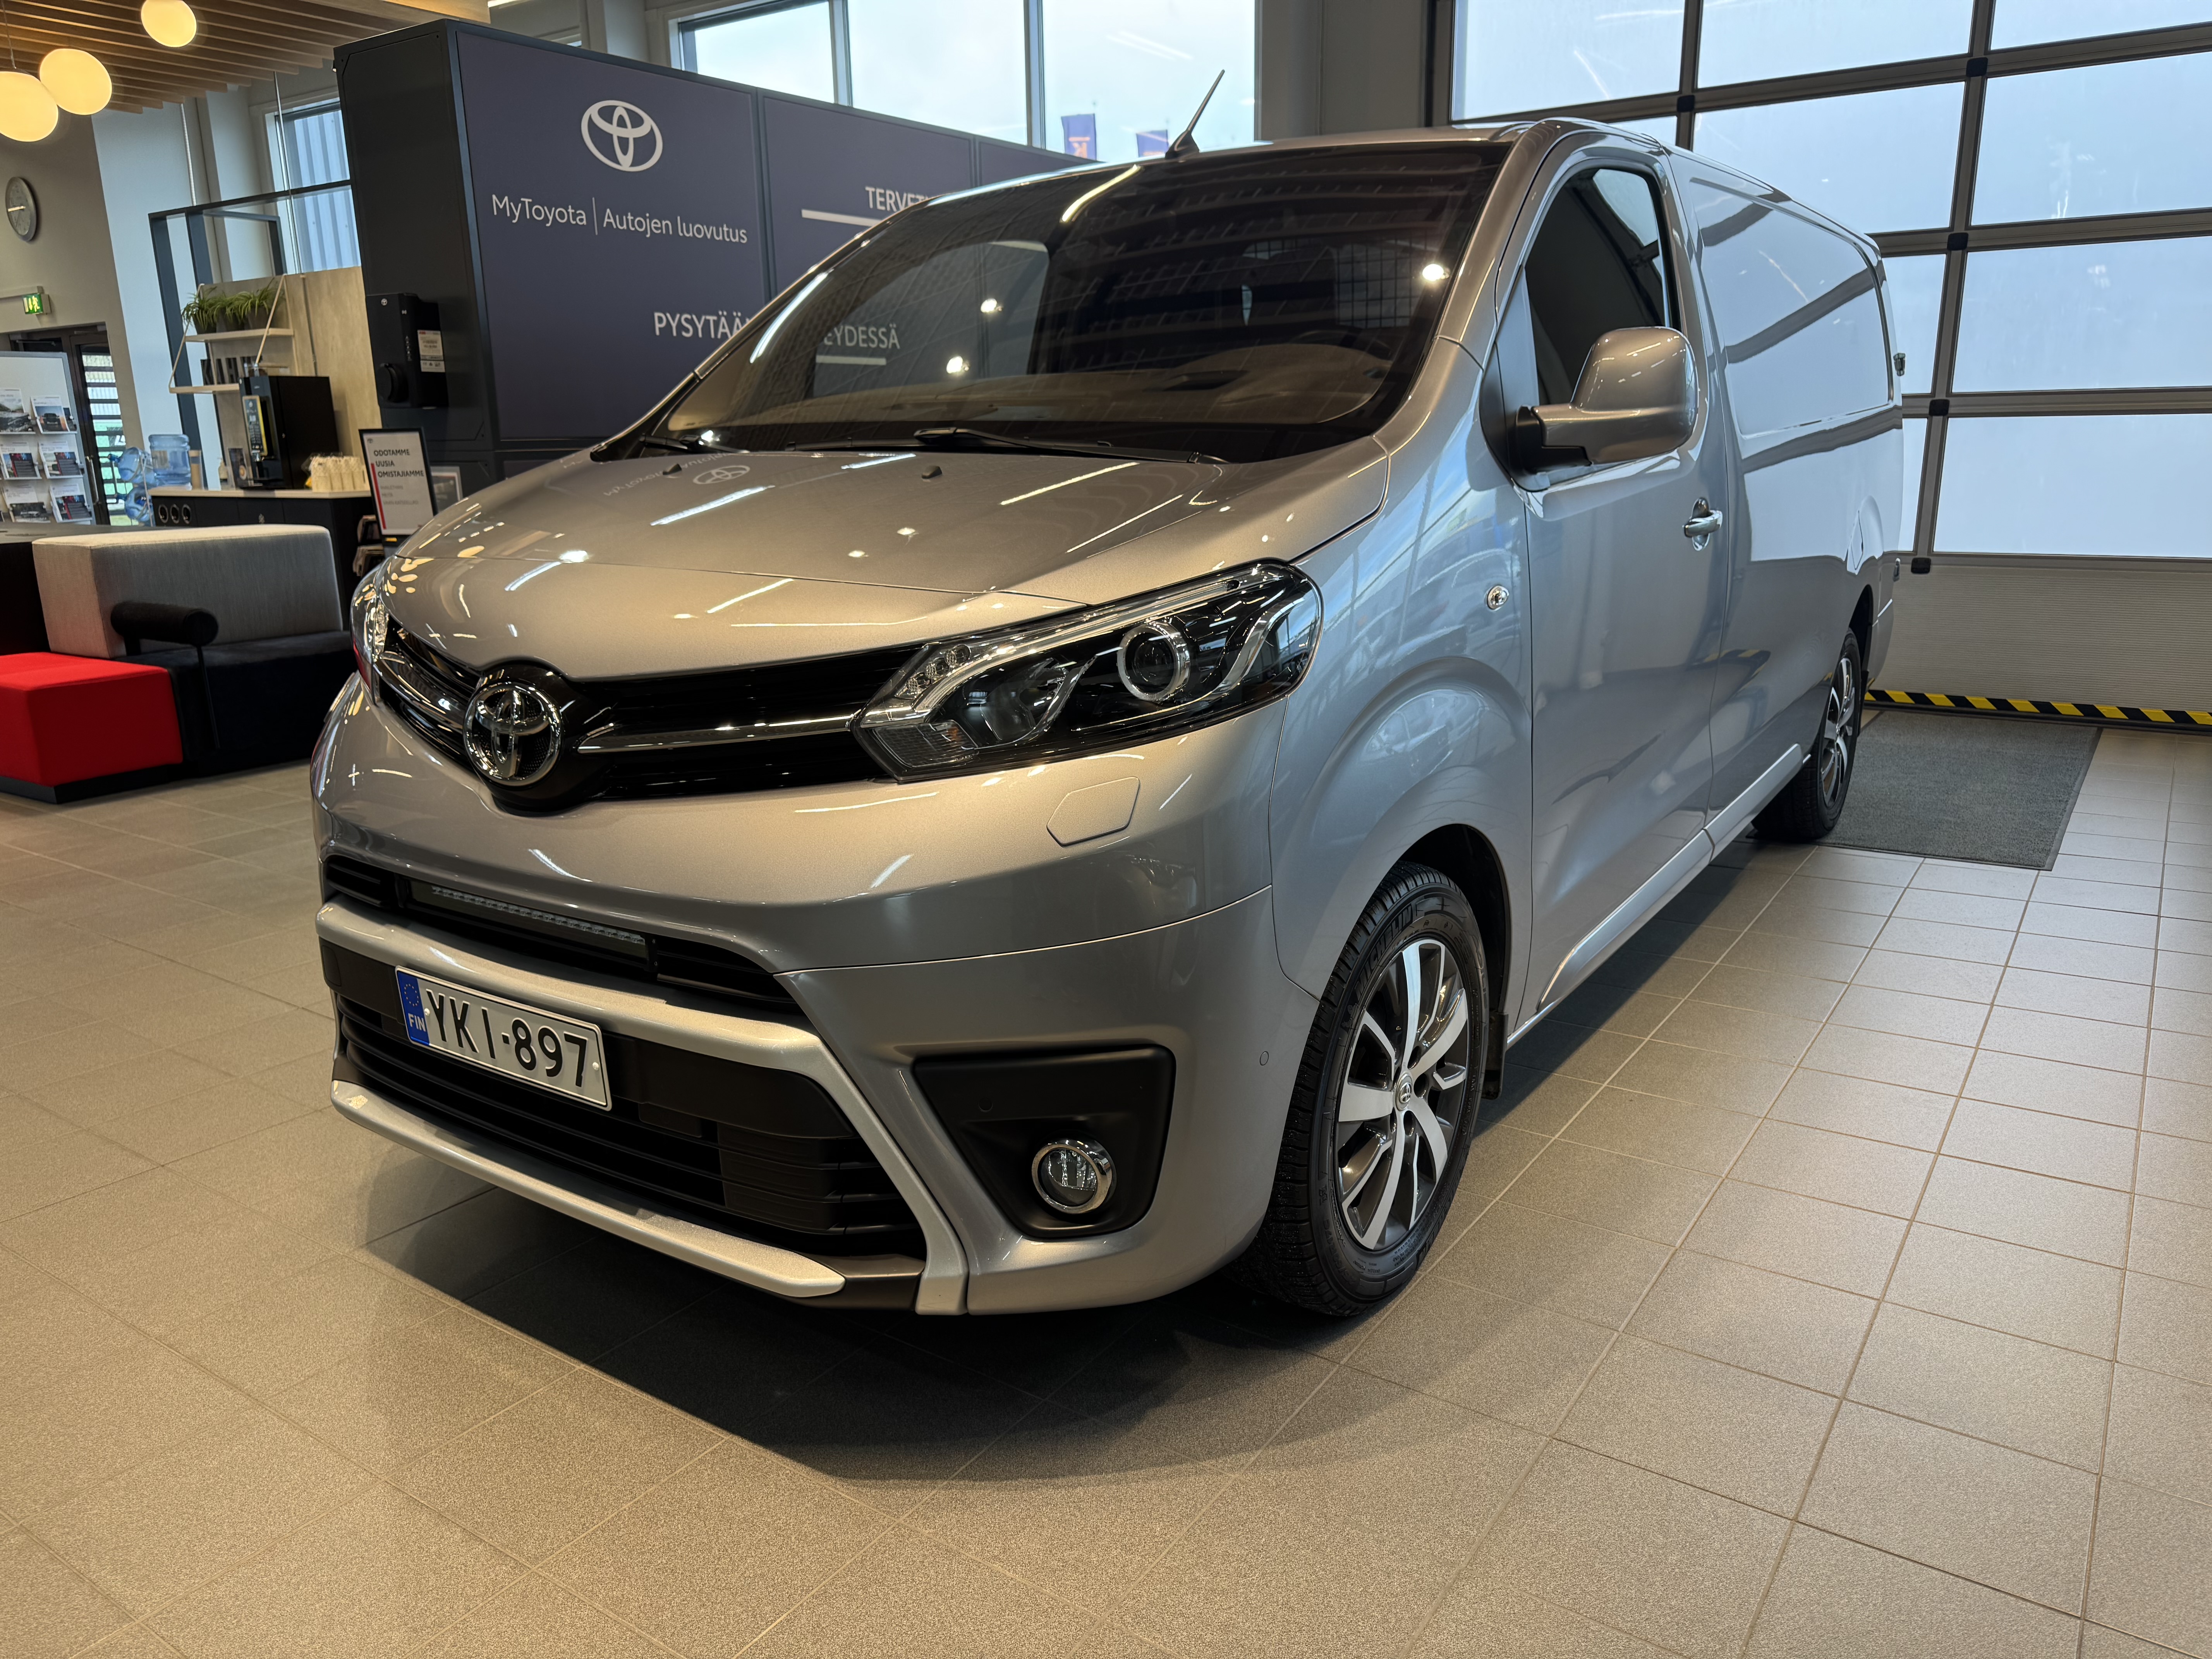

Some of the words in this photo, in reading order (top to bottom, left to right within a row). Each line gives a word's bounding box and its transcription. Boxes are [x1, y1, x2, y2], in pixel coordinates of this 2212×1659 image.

[492, 194, 586, 227] MyToyota
[603, 208, 672, 237] Autojen
[677, 216, 747, 243] luovutus
[865, 186, 929, 212] TERVE
[654, 310, 750, 339] PYSYTÄÄ
[1354, 903, 1413, 1002] MICHELIN
[408, 1013, 426, 1032] FIN
[426, 989, 588, 1088] YKI-897
